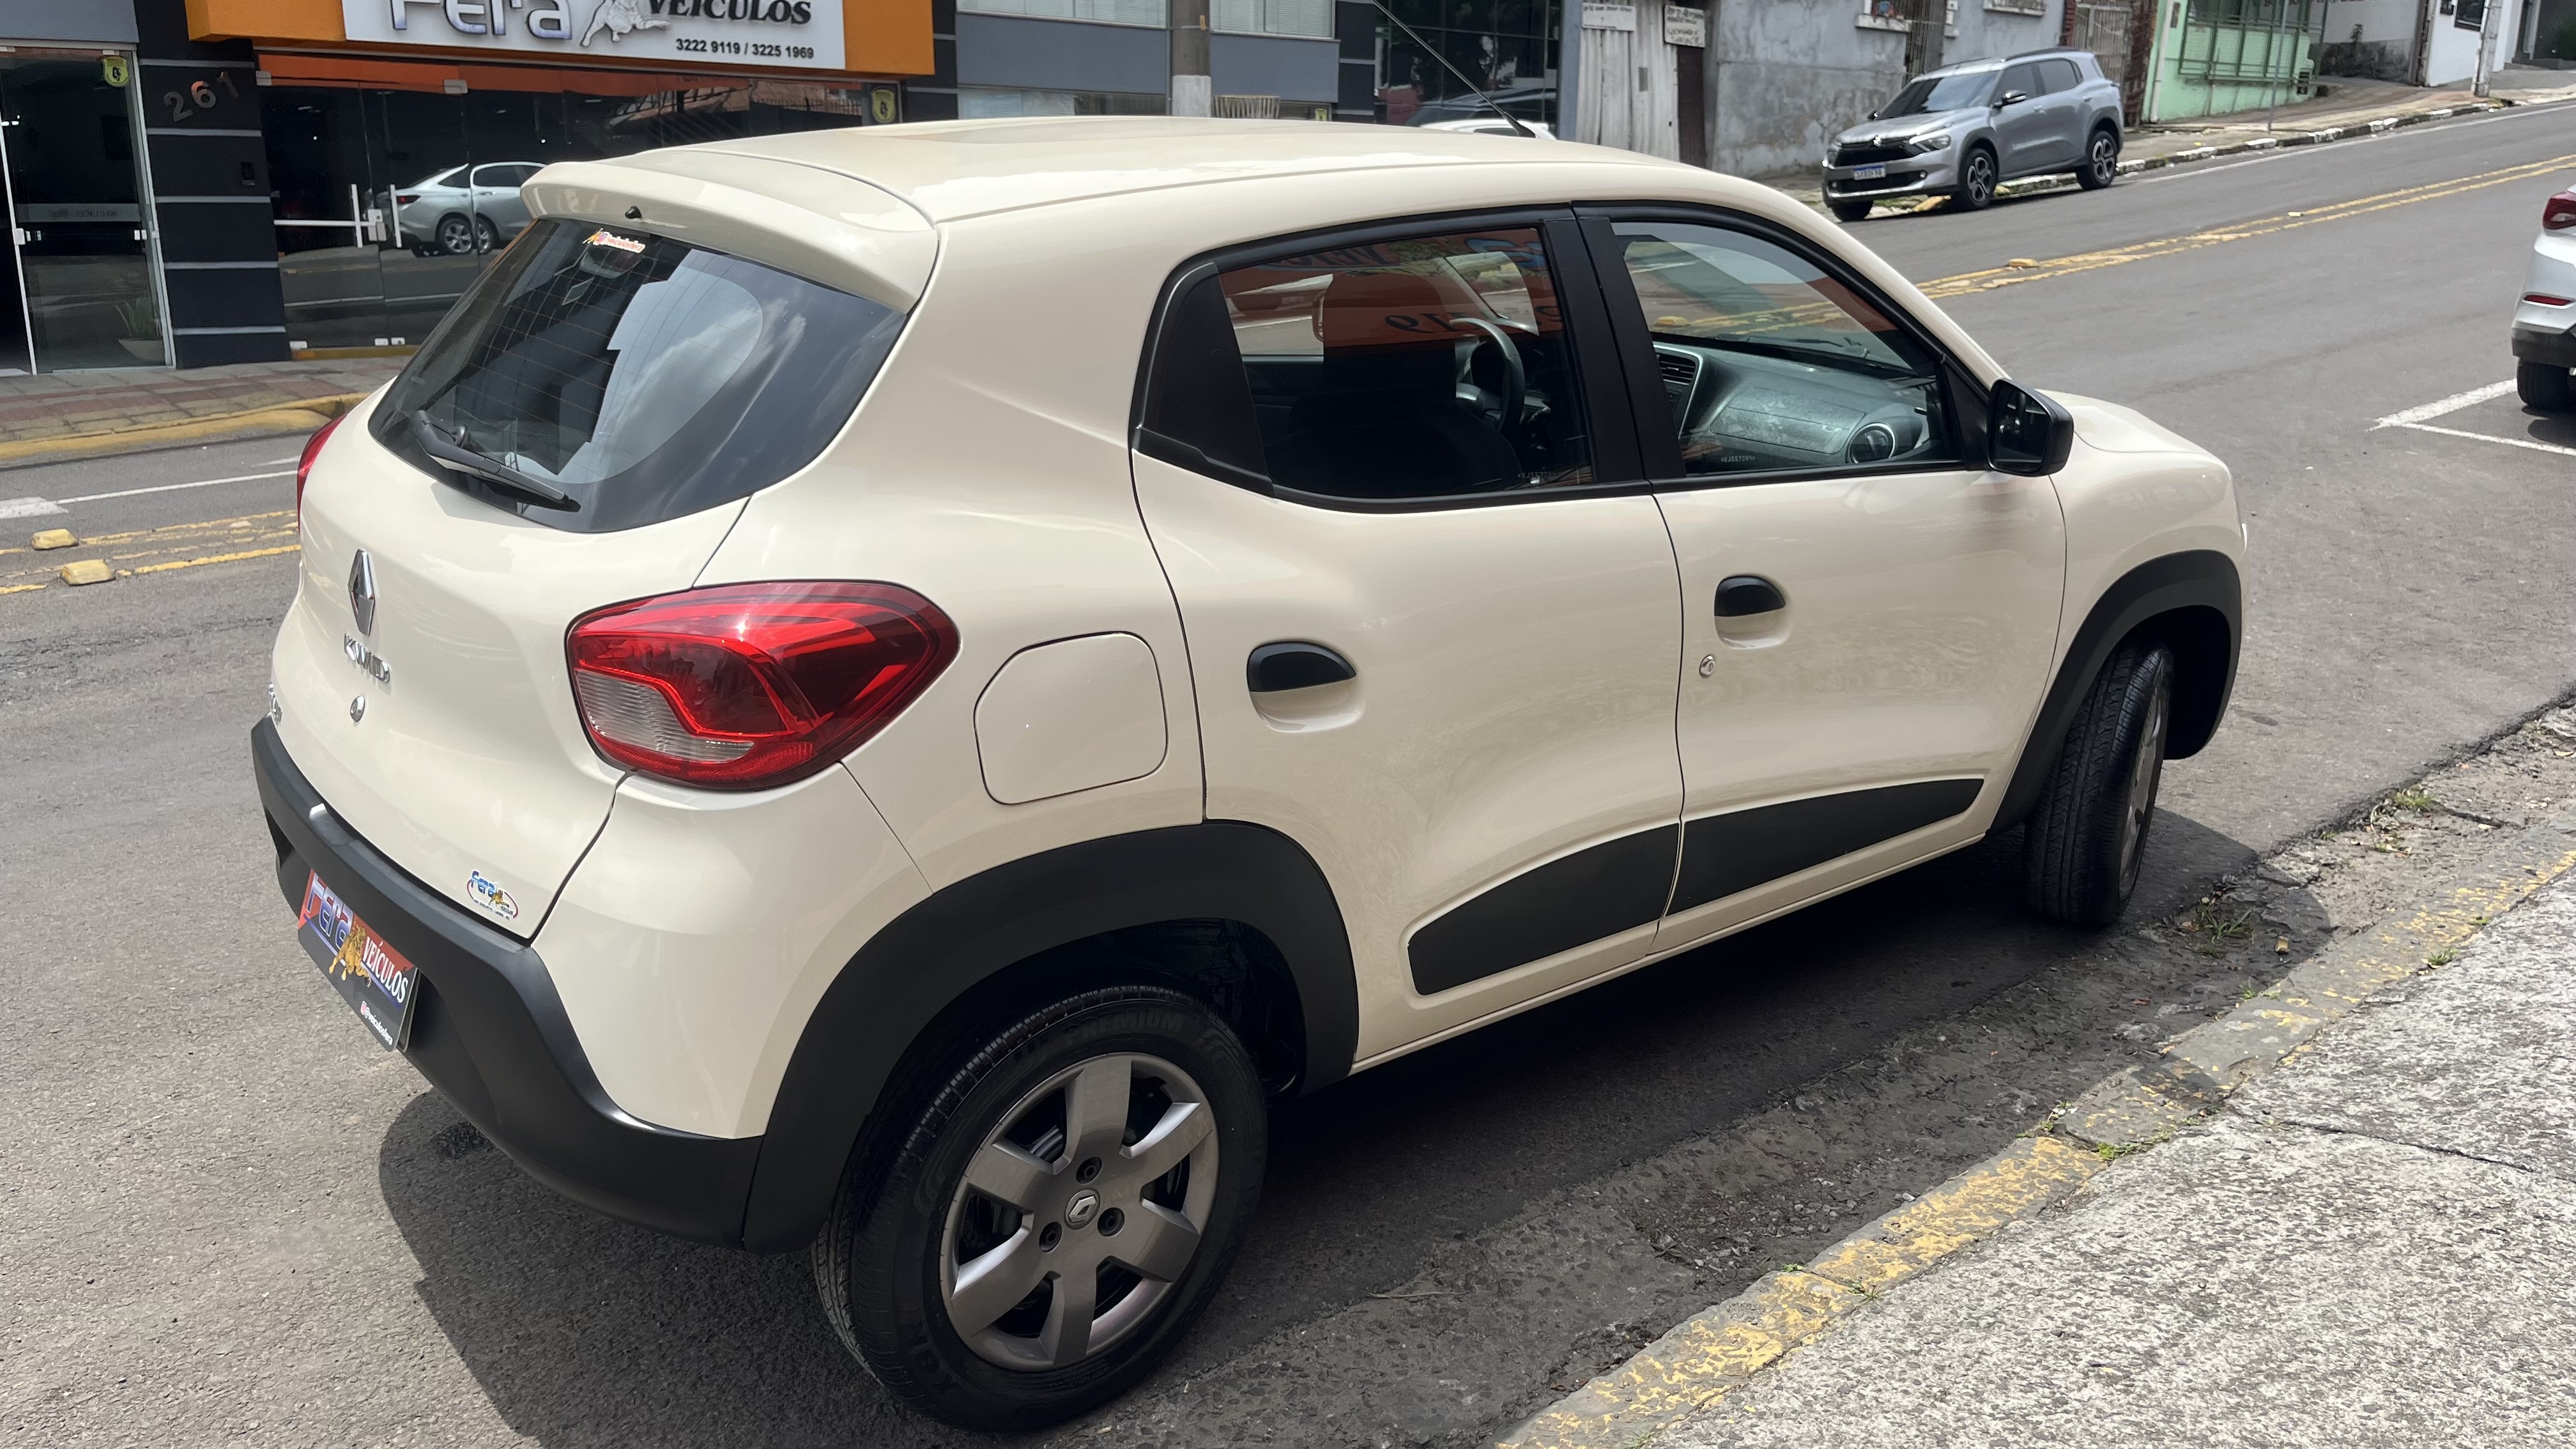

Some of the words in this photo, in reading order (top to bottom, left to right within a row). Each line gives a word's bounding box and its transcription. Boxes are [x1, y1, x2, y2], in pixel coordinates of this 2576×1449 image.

[676, 38, 707, 52] 3222
[711, 41, 740, 54] 9119
[752, 43, 781, 57] 3225
[785, 45, 814, 59] 1969
[164, 71, 240, 122] 261
[344, 633, 390, 683] KWID
[363, 937, 409, 1004] VEÍCULOS
